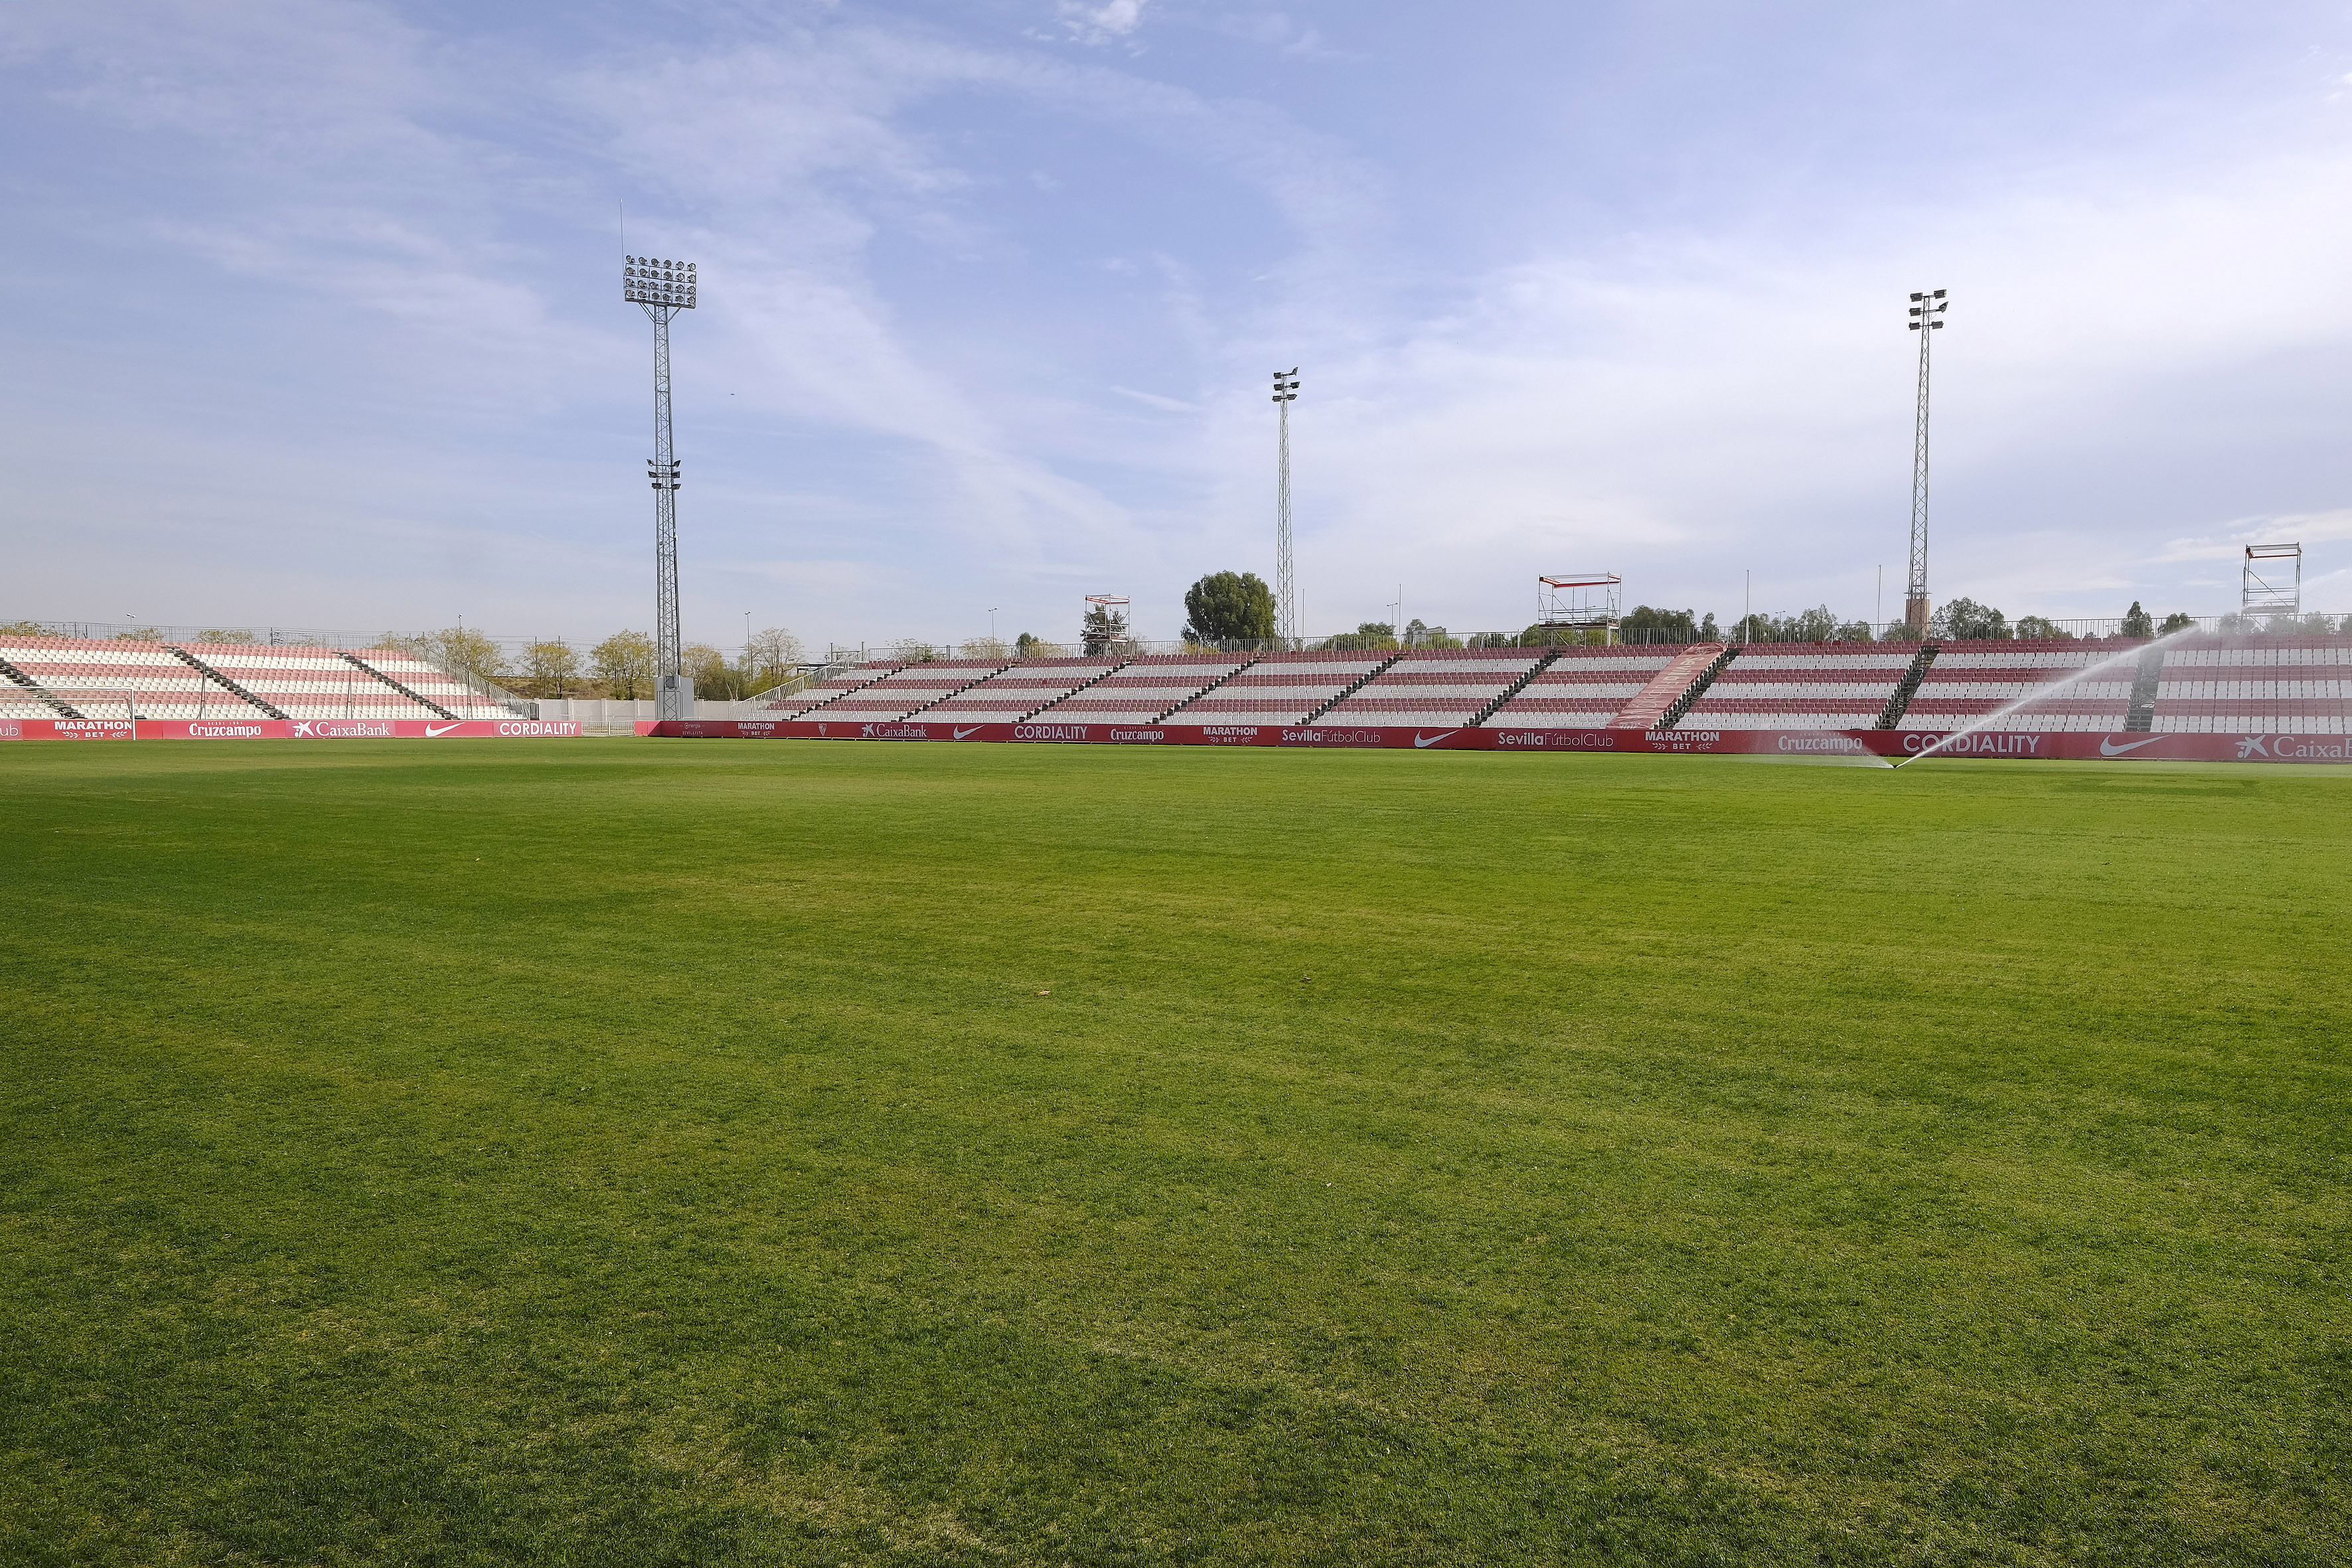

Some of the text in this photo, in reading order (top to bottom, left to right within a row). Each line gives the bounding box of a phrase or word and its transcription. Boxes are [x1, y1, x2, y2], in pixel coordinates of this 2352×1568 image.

[54, 721, 132, 730] MARATHON
[189, 723, 262, 738] Cruzcampo
[315, 722, 391, 736] CaixaBank
[499, 722, 577, 736] CORDIALITY
[876, 724, 927, 738] CaixaBank
[1014, 725, 1088, 740] CORDIALITY
[1203, 727, 1258, 736] MARATHON
[1110, 728, 1164, 742] Cruzcampo
[1645, 731, 1720, 742] MARATHON
[1778, 735, 1863, 752] Cruzcampo
[1903, 733, 2041, 753] CORDIALITY
